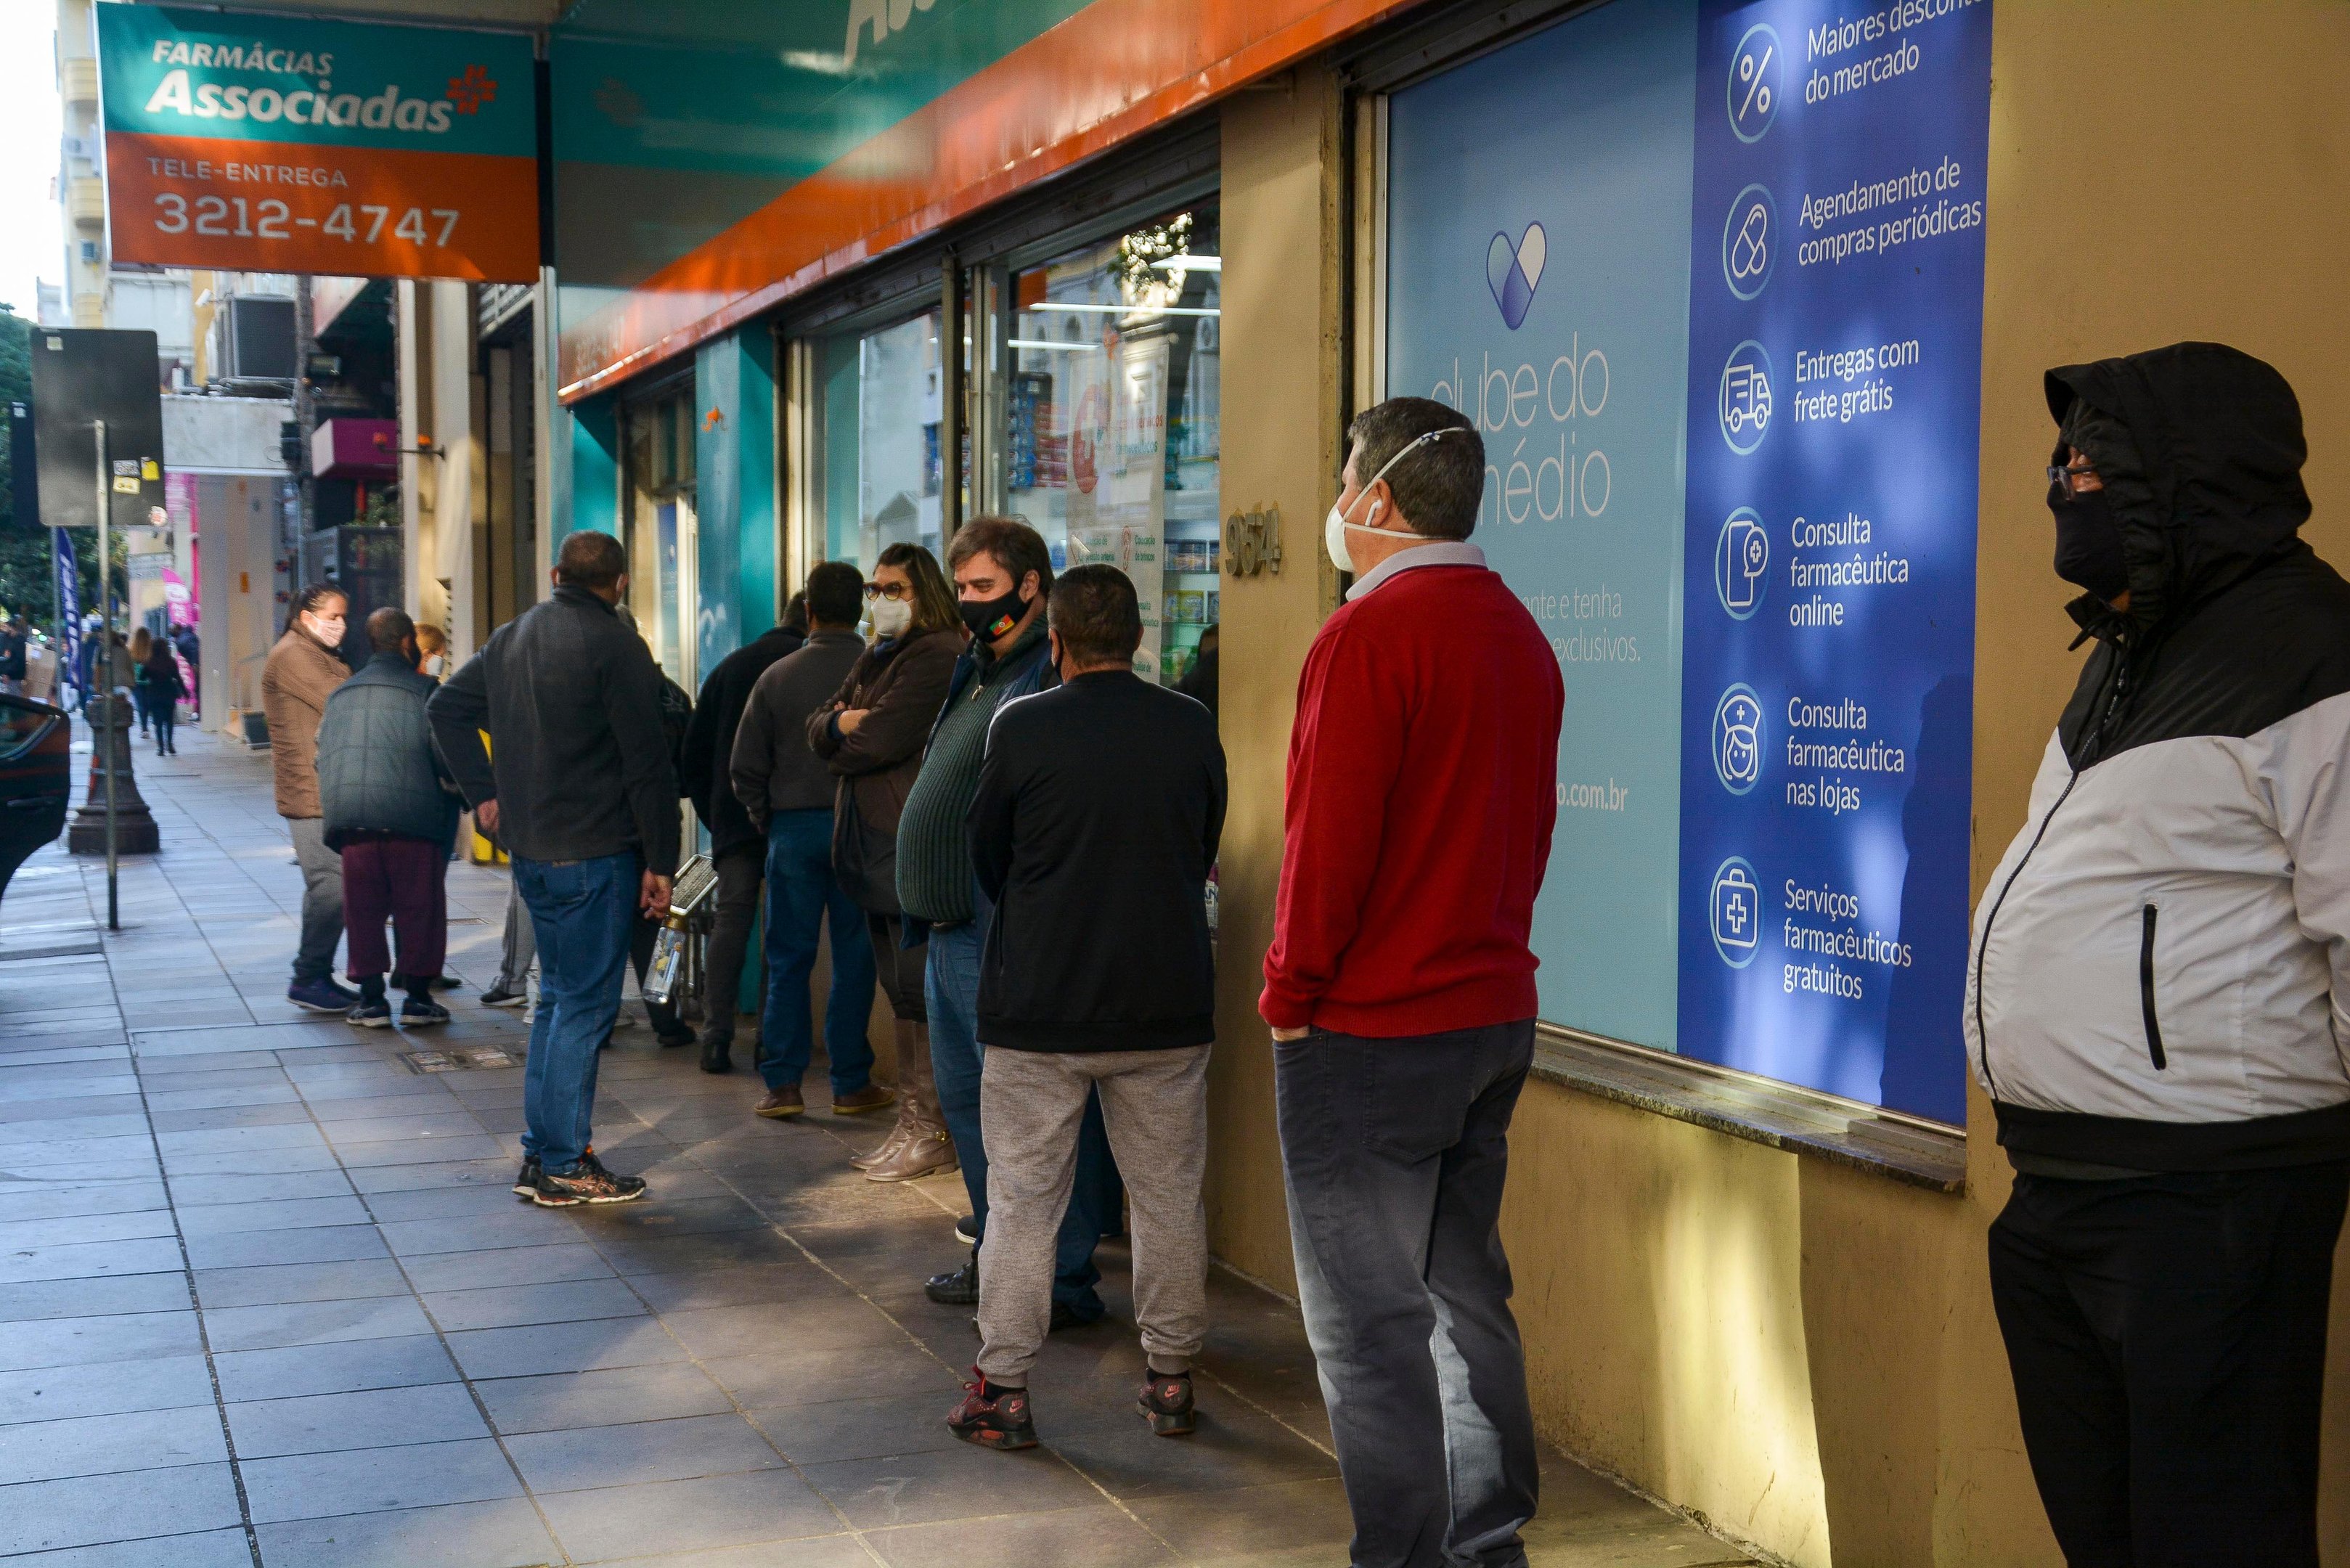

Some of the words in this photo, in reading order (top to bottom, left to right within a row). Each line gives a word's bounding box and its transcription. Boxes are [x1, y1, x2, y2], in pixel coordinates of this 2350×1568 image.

[152, 40, 334, 75] FARMÁCIAS
[1808, 12, 1886, 62] Maiores
[1806, 68, 1829, 105] do
[1833, 38, 1920, 96] mercado
[144, 69, 454, 133] Associadas
[147, 156, 348, 189] TELE-ENTREGA
[1800, 166, 1931, 230] Agendamento
[1935, 155, 1961, 192] de
[155, 192, 460, 248] 3212-4747
[1798, 225, 1875, 266] compras
[1879, 199, 1982, 255] periódicas
[1548, 330, 1609, 422] do
[1795, 347, 1875, 383] Entregas
[1878, 339, 1919, 369] com
[1794, 389, 1837, 422] frete
[1840, 377, 1893, 424] grátis
[1791, 512, 1871, 547] Consulta
[1790, 550, 1909, 587] farmacêutica
[1561, 595, 1570, 618] e
[1573, 582, 1622, 618] tenha
[1790, 595, 1844, 627] online
[1552, 627, 1641, 662] exclusivos.
[1787, 696, 1867, 730] Consulta
[1787, 735, 1905, 772] farmacêutica
[1787, 782, 1816, 807] nas
[1819, 775, 1861, 816] lojas
[1784, 878, 1859, 923] Serviços
[1784, 917, 1912, 968] farmacêuticos
[1783, 962, 1863, 1000] gratuitos
